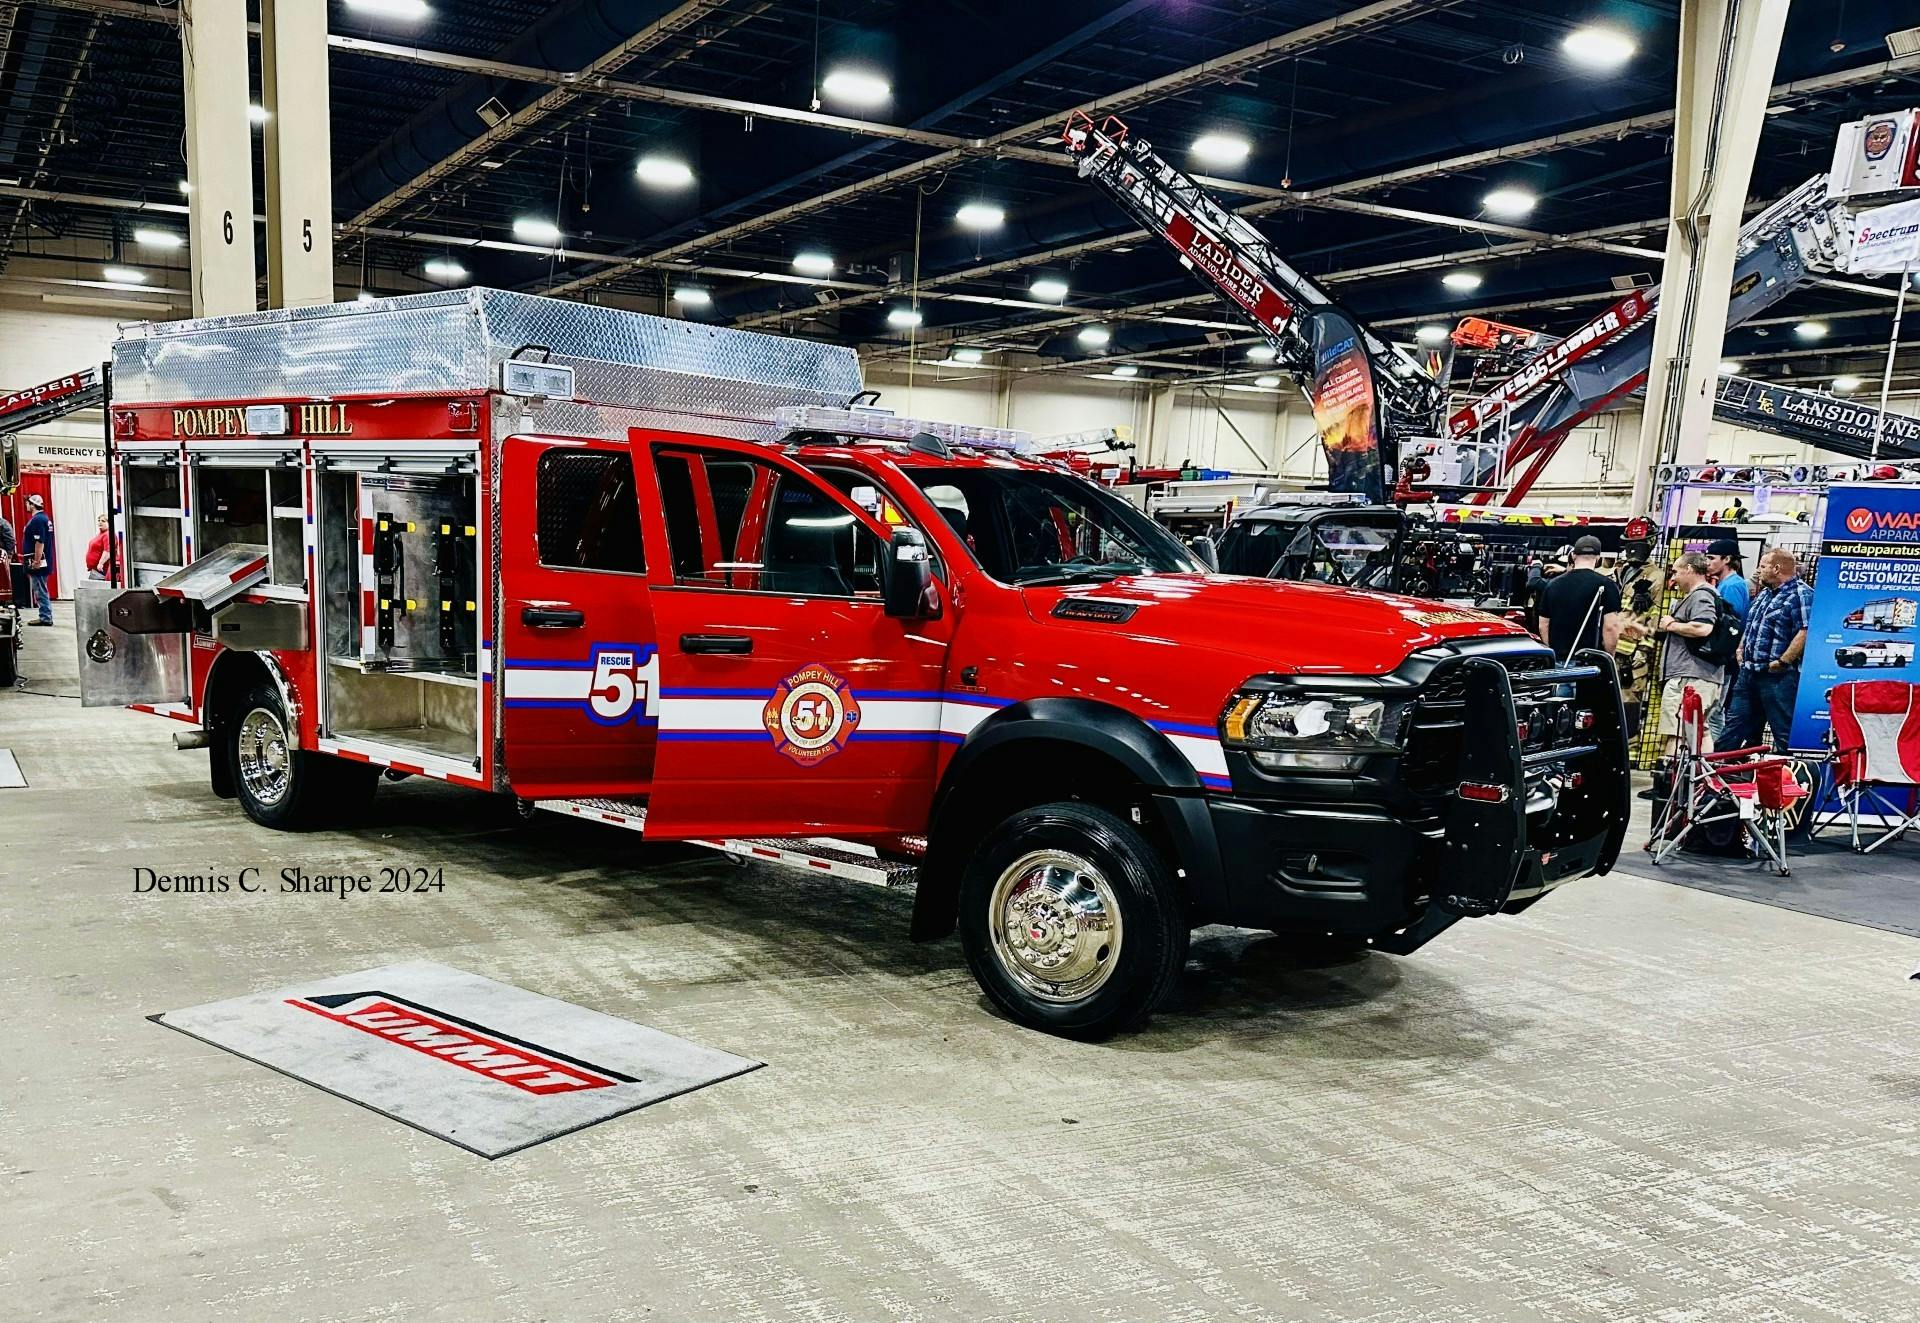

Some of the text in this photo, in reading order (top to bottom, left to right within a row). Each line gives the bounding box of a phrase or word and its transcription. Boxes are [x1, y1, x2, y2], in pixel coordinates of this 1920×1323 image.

[223, 210, 233, 245] 6
[302, 218, 312, 252] 5
[1858, 224, 1919, 244] Spectrum
[1220, 272, 1238, 291] FIRE
[1523, 358, 1549, 390] 25
[1546, 311, 1620, 366] LADDER
[172, 403, 353, 437] POMPEY HILL
[1781, 394, 1920, 440] LANSDOWNE
[1787, 412, 1905, 447] TRUCK COMPANY
[38, 446, 94, 458] EMERGENCY
[1870, 529, 1920, 541] APPARA
[1840, 561, 1891, 572] PREMIUM
[600, 656, 631, 666] RESCUE
[590, 652, 660, 717] 51
[787, 670, 839, 688] POMPEY HILL
[795, 700, 828, 732] 51
[788, 744, 821, 758] VOLUNTEER
